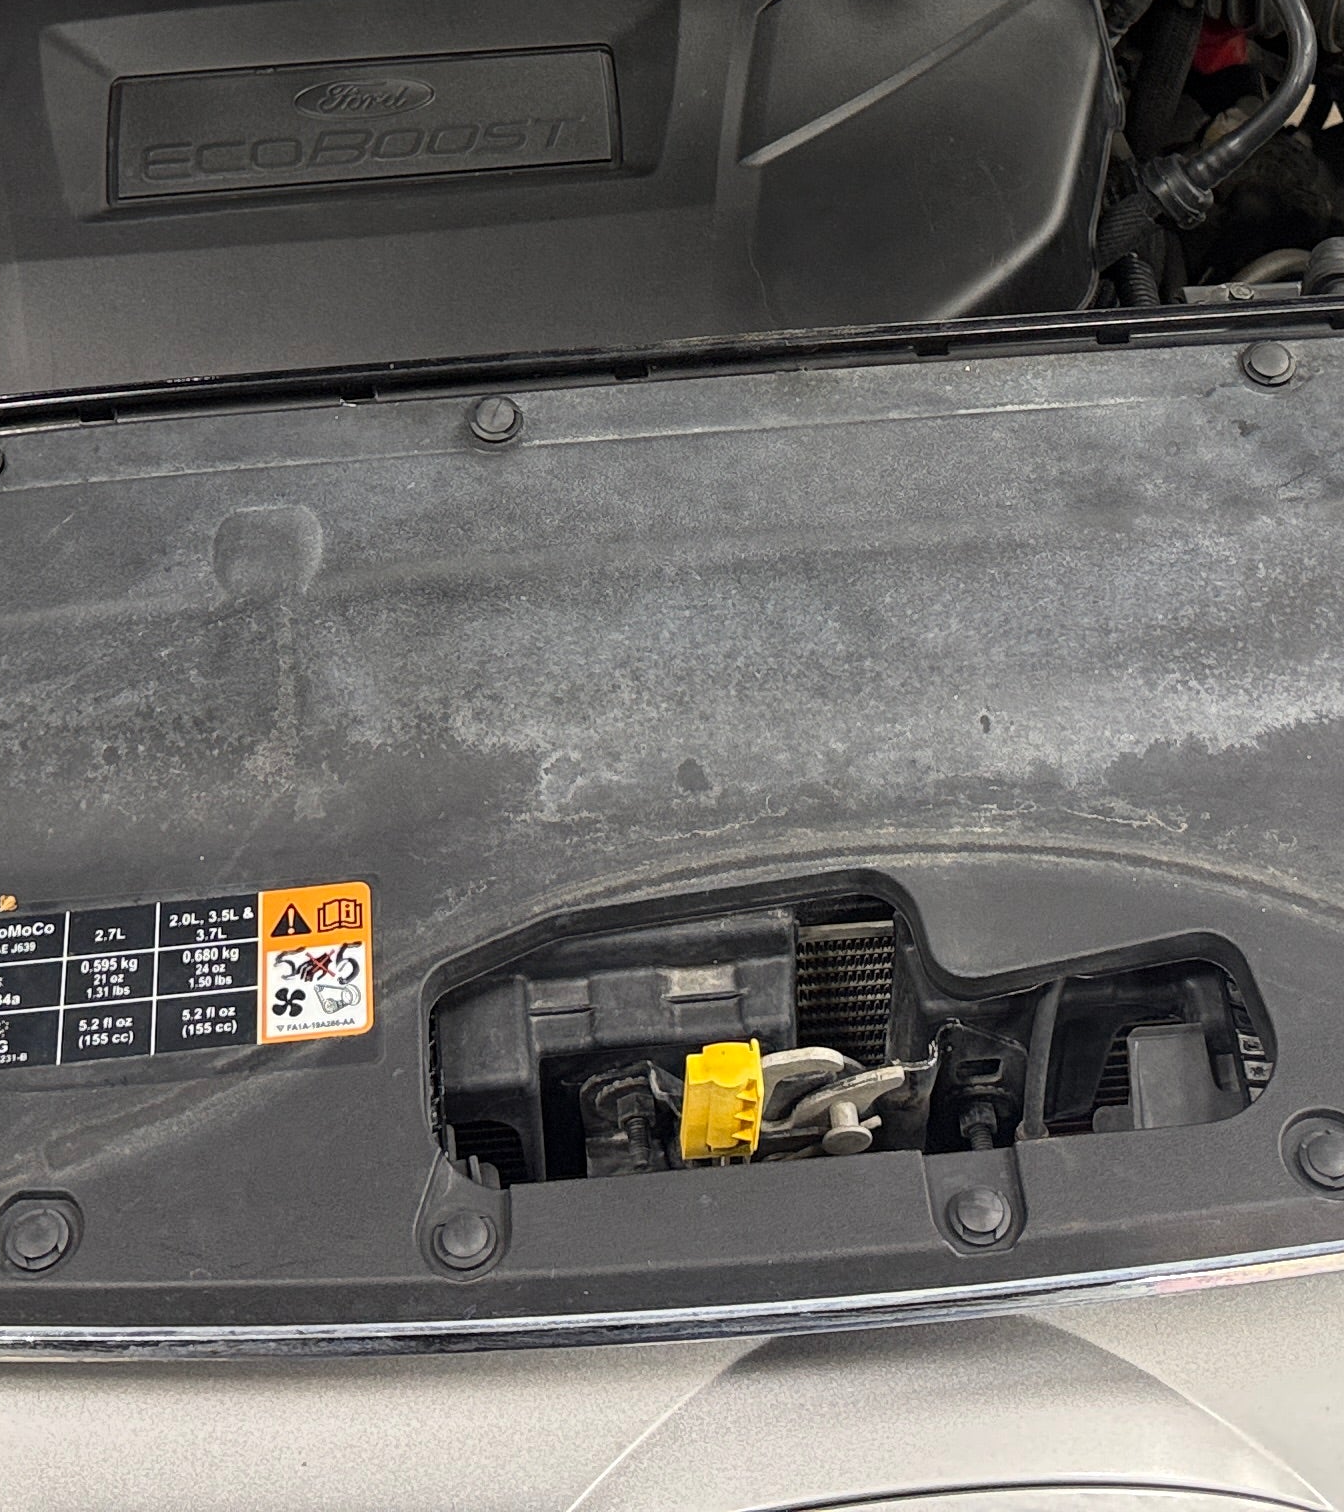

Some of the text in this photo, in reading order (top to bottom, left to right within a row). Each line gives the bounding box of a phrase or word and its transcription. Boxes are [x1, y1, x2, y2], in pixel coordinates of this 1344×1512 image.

[318, 80, 408, 114] Ford
[169, 907, 254, 927] 2.0L, 3.5L &
[94, 928, 126, 942] 2.7L
[196, 927, 227, 942] 3.7L
[11, 941, 36, 954] J639
[182, 947, 239, 964] 0.680 kg
[80, 957, 138, 974] 0.595 kg
[196, 963, 226, 975] 24 oz
[93, 974, 124, 985] 21 oz
[188, 974, 233, 989] 1.50 lbs
[86, 985, 131, 999] 1.31 lbs
[182, 1006, 236, 1021] 5.2 fl oz
[78, 1017, 133, 1032] 5.2 fl oz
[182, 1020, 238, 1039] (155 cc)
[78, 1030, 134, 1049] (155 cc)
